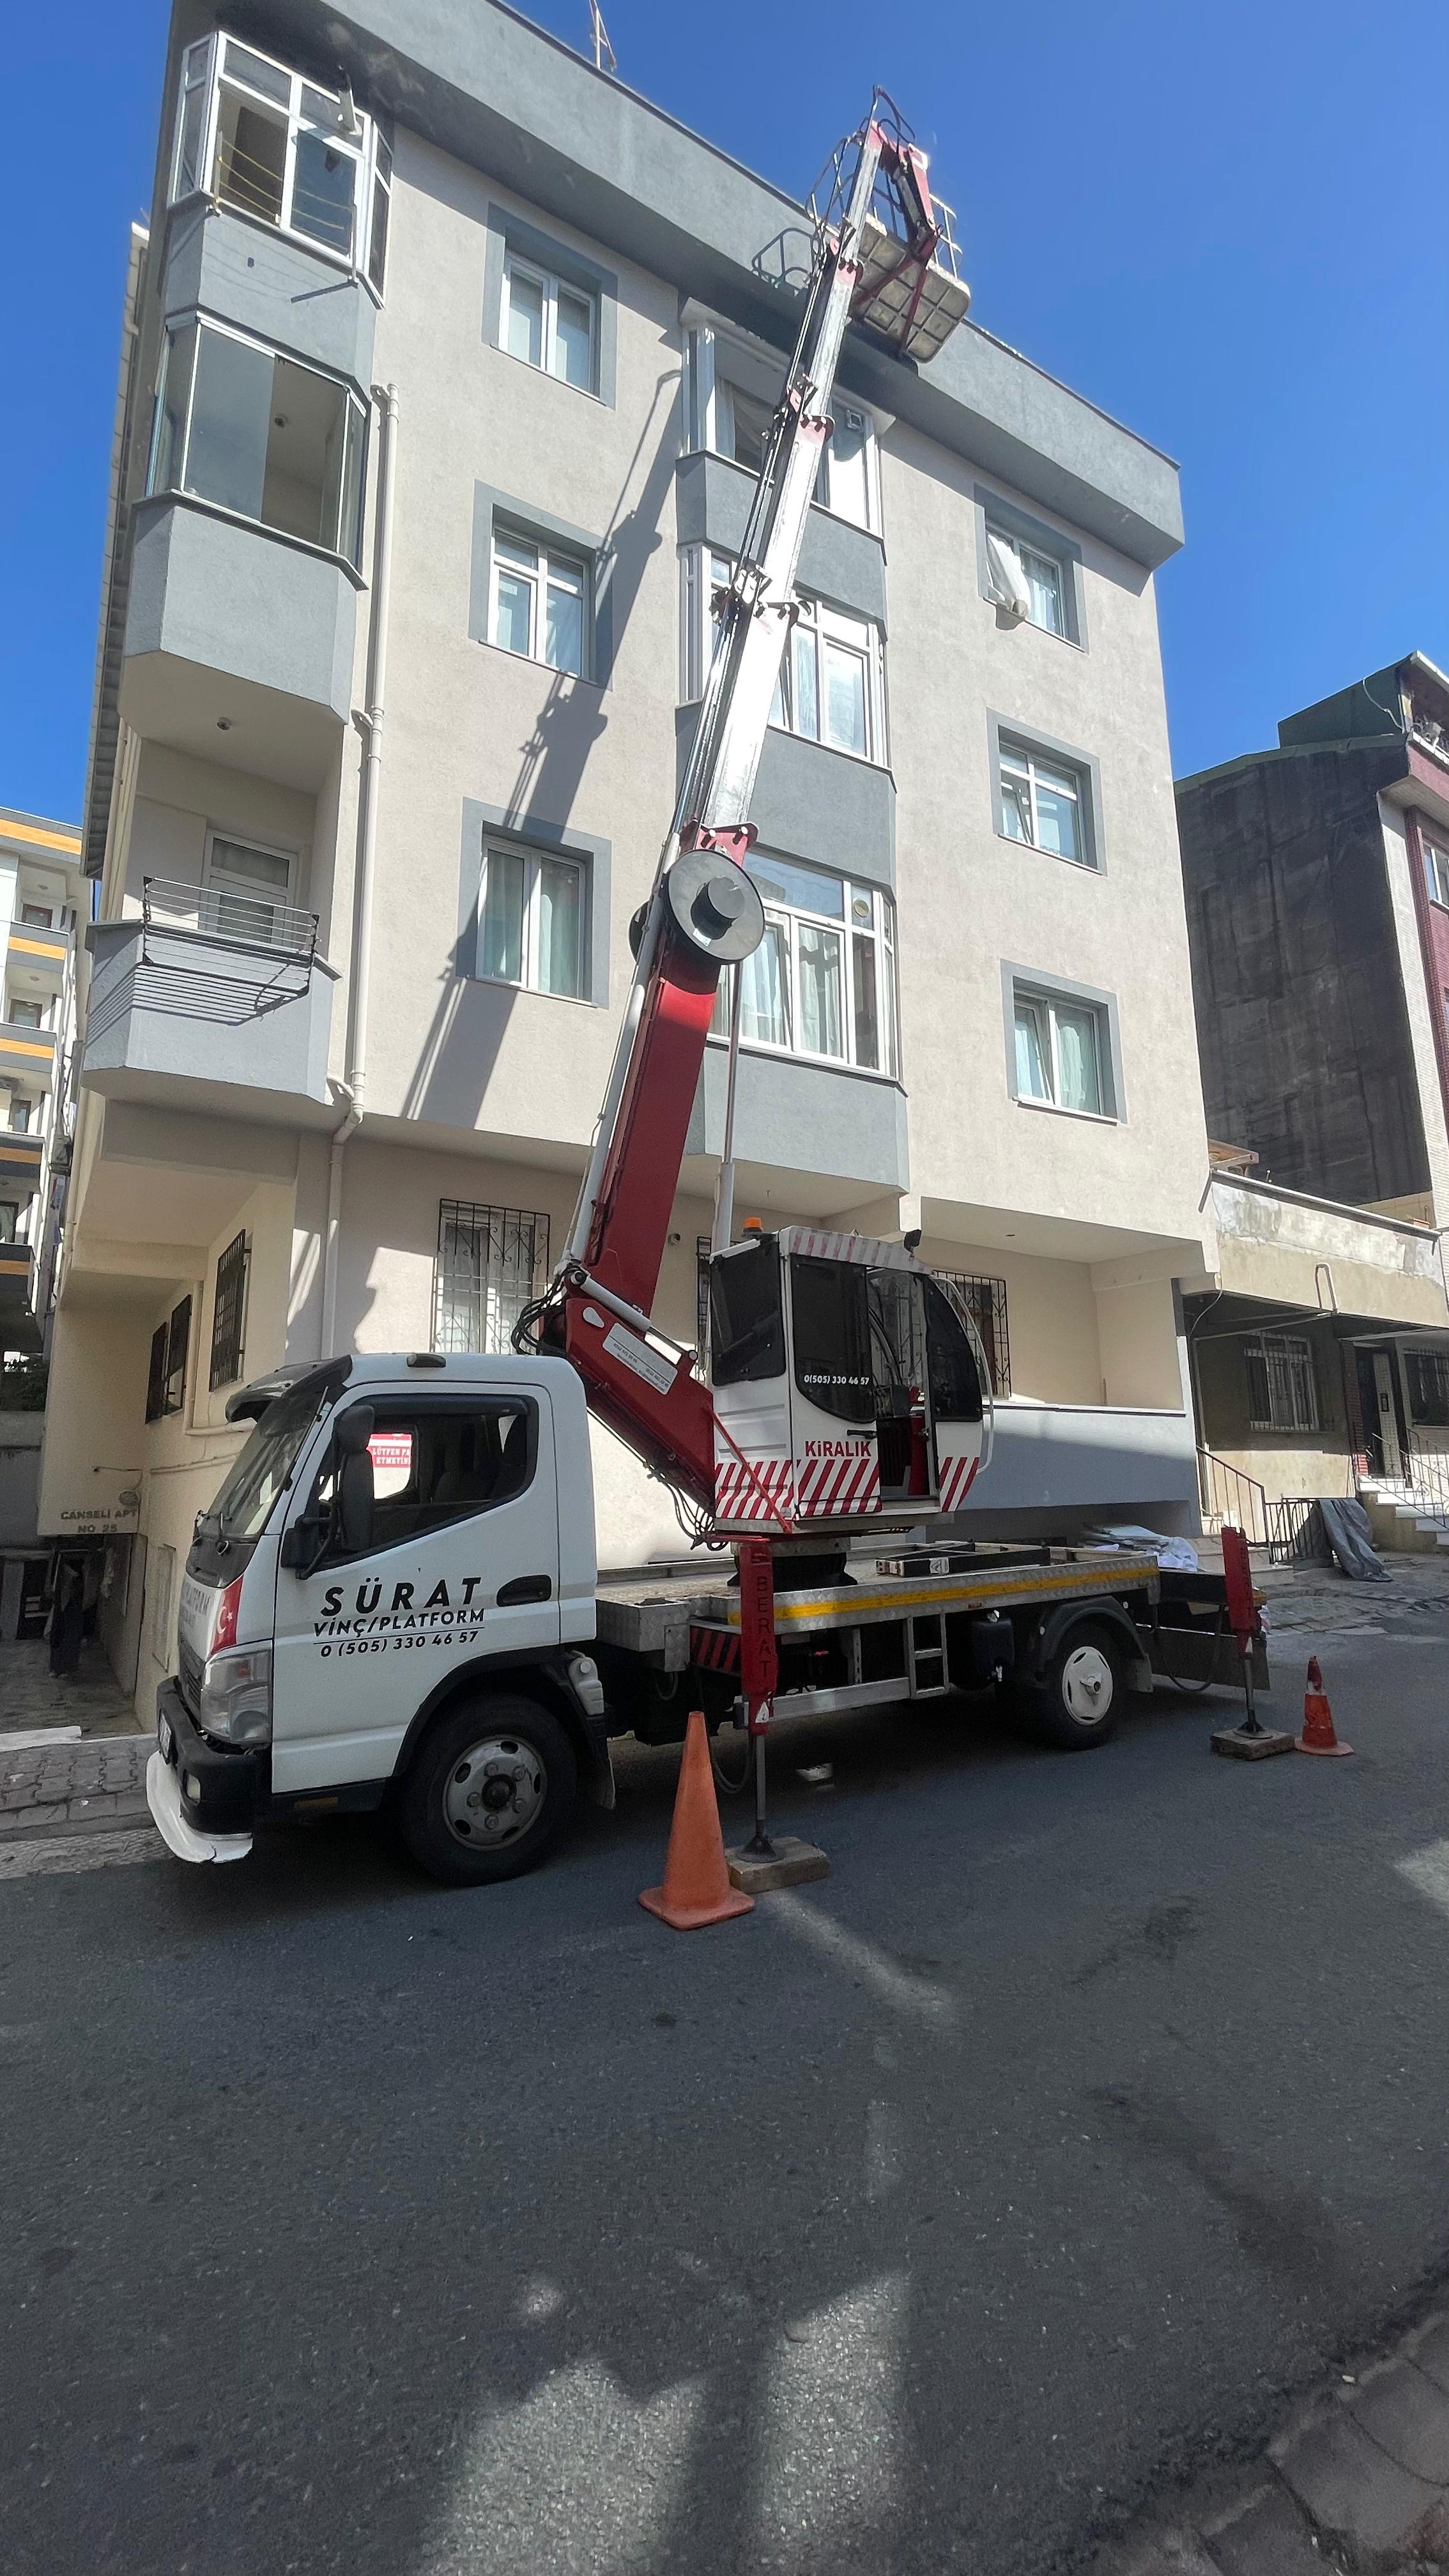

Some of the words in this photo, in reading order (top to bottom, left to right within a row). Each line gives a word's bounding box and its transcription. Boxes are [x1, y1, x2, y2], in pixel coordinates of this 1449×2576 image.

[804, 1374, 831, 1384] 0(505)
[832, 1376, 847, 1384] 330
[848, 1376, 859, 1385] 46
[860, 1377, 870, 1385] 57
[372, 1446, 400, 1455] LÜTFEN
[115, 1508, 137, 1519] APT
[77, 1524, 96, 1533] NO
[320, 1577, 482, 1617] SÜRAT
[314, 1608, 485, 1638] VİNÇ/PLATFORM
[756, 1575, 772, 1678] BERAT
[321, 1644, 332, 1657] 0
[338, 1640, 387, 1657] (505)
[393, 1636, 425, 1650] 330
[431, 1633, 452, 1646] 46
[459, 1630, 479, 1643] 57
